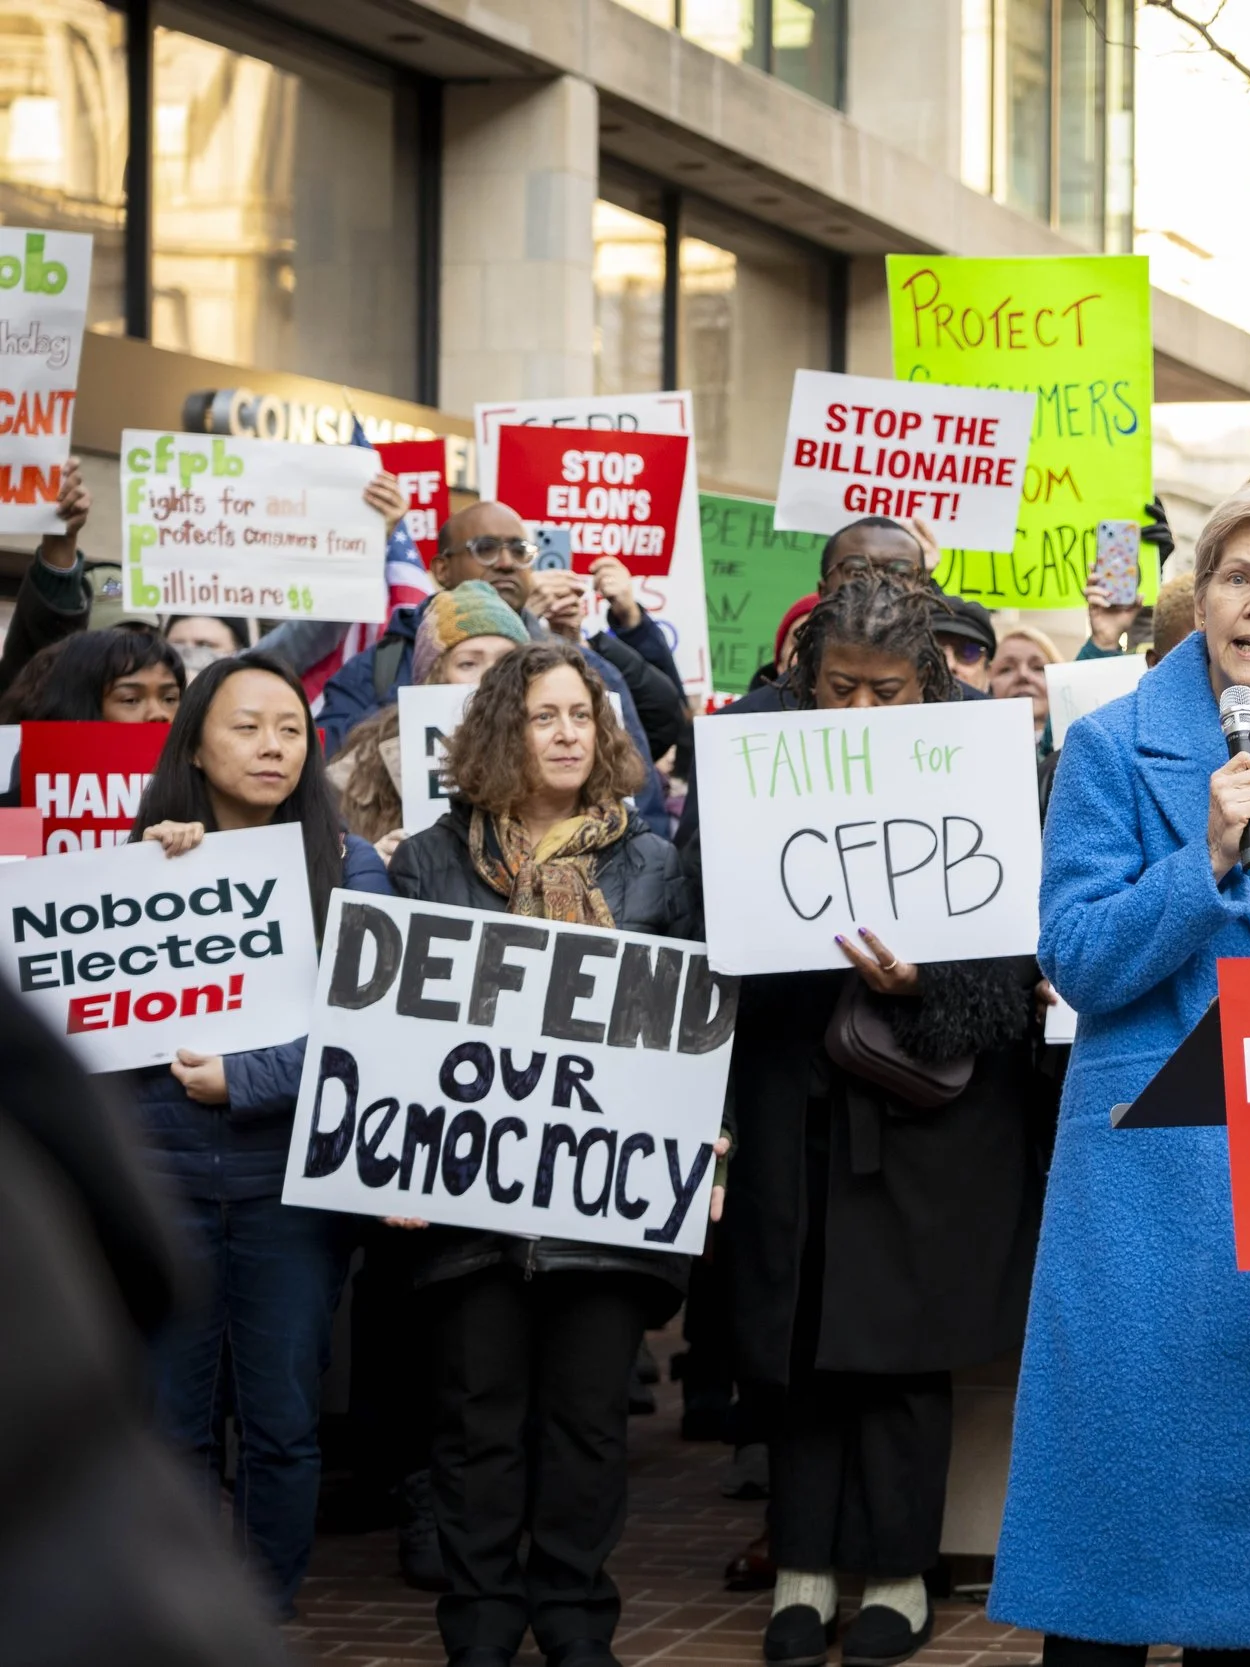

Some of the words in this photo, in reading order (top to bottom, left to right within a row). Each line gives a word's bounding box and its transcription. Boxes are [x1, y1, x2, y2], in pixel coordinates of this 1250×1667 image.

[902, 269, 1101, 350] PROTECT
[825, 403, 922, 440] STOP
[933, 414, 1000, 448] THE
[127, 435, 244, 488] cfpb
[562, 449, 644, 485] STOP
[794, 438, 1017, 487] BILLIONAIRE
[219, 487, 255, 516] for
[547, 485, 651, 521] ELON'S
[843, 483, 960, 521] GRIFT!
[326, 530, 366, 555] from
[731, 726, 874, 798] FAITH
[910, 738, 964, 773] for
[780, 816, 1003, 922] CFPB
[12, 877, 278, 943] Nobody
[17, 921, 284, 992] Elected
[328, 902, 741, 1055] DEFEND
[66, 973, 245, 1035] Elon!
[439, 1041, 604, 1114] OUR
[302, 1046, 715, 1244] Democracy
